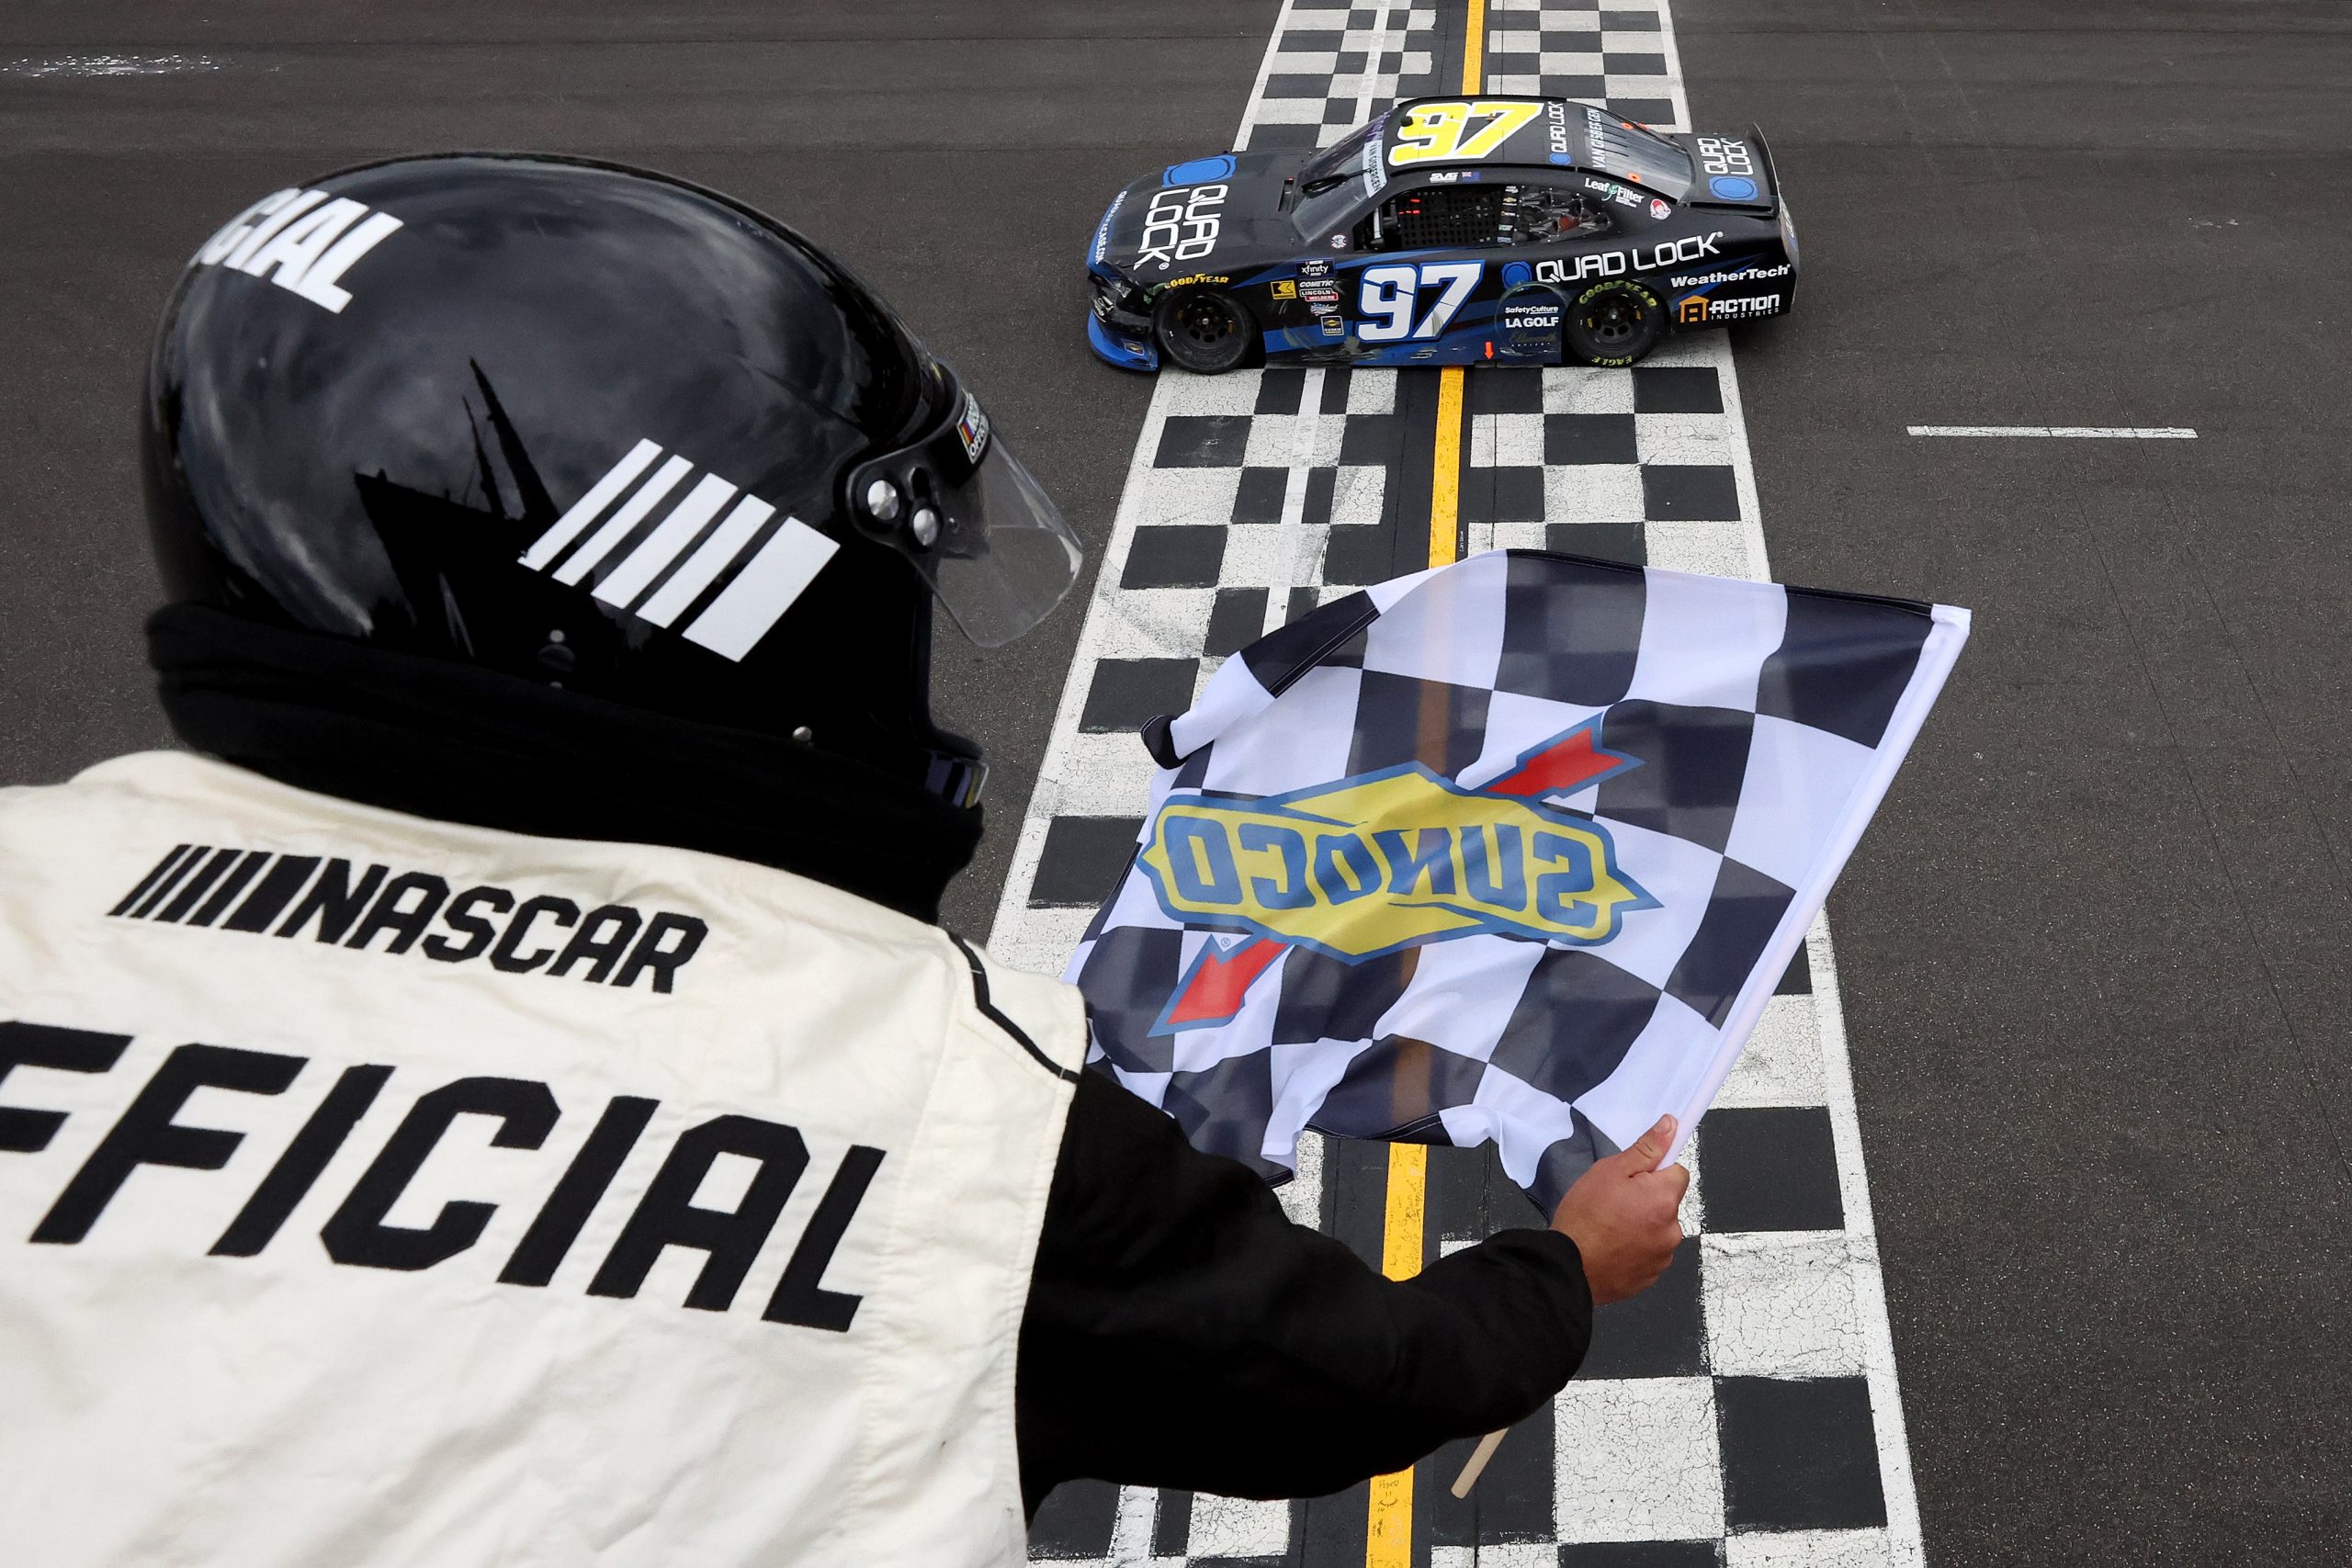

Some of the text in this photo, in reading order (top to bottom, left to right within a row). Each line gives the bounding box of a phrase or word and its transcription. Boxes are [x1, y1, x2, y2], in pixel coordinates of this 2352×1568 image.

[1388, 102, 1544, 166] 97
[1548, 101, 1567, 153] QUAD LOCK
[1591, 148, 1606, 168] VAN
[1697, 138, 1729, 175] QUAD
[1723, 140, 1754, 175] LOCK
[1430, 172, 1459, 183] SVG
[1585, 177, 1610, 192] Leaf
[1617, 186, 1645, 203] Filter
[1133, 188, 1191, 271] LOCK
[1175, 185, 1229, 261] QUAD
[1301, 265, 1329, 275] xfinity
[1535, 232, 1721, 284] QUAD LOCK
[1670, 265, 1788, 288] WeatherTech
[1356, 262, 1484, 342] 97
[1709, 294, 1781, 313] ACTION
[1711, 308, 1780, 320] INDUSTRIES
[1505, 317, 1559, 328] LA GOLF
[272, 856, 709, 994] NASCAR
